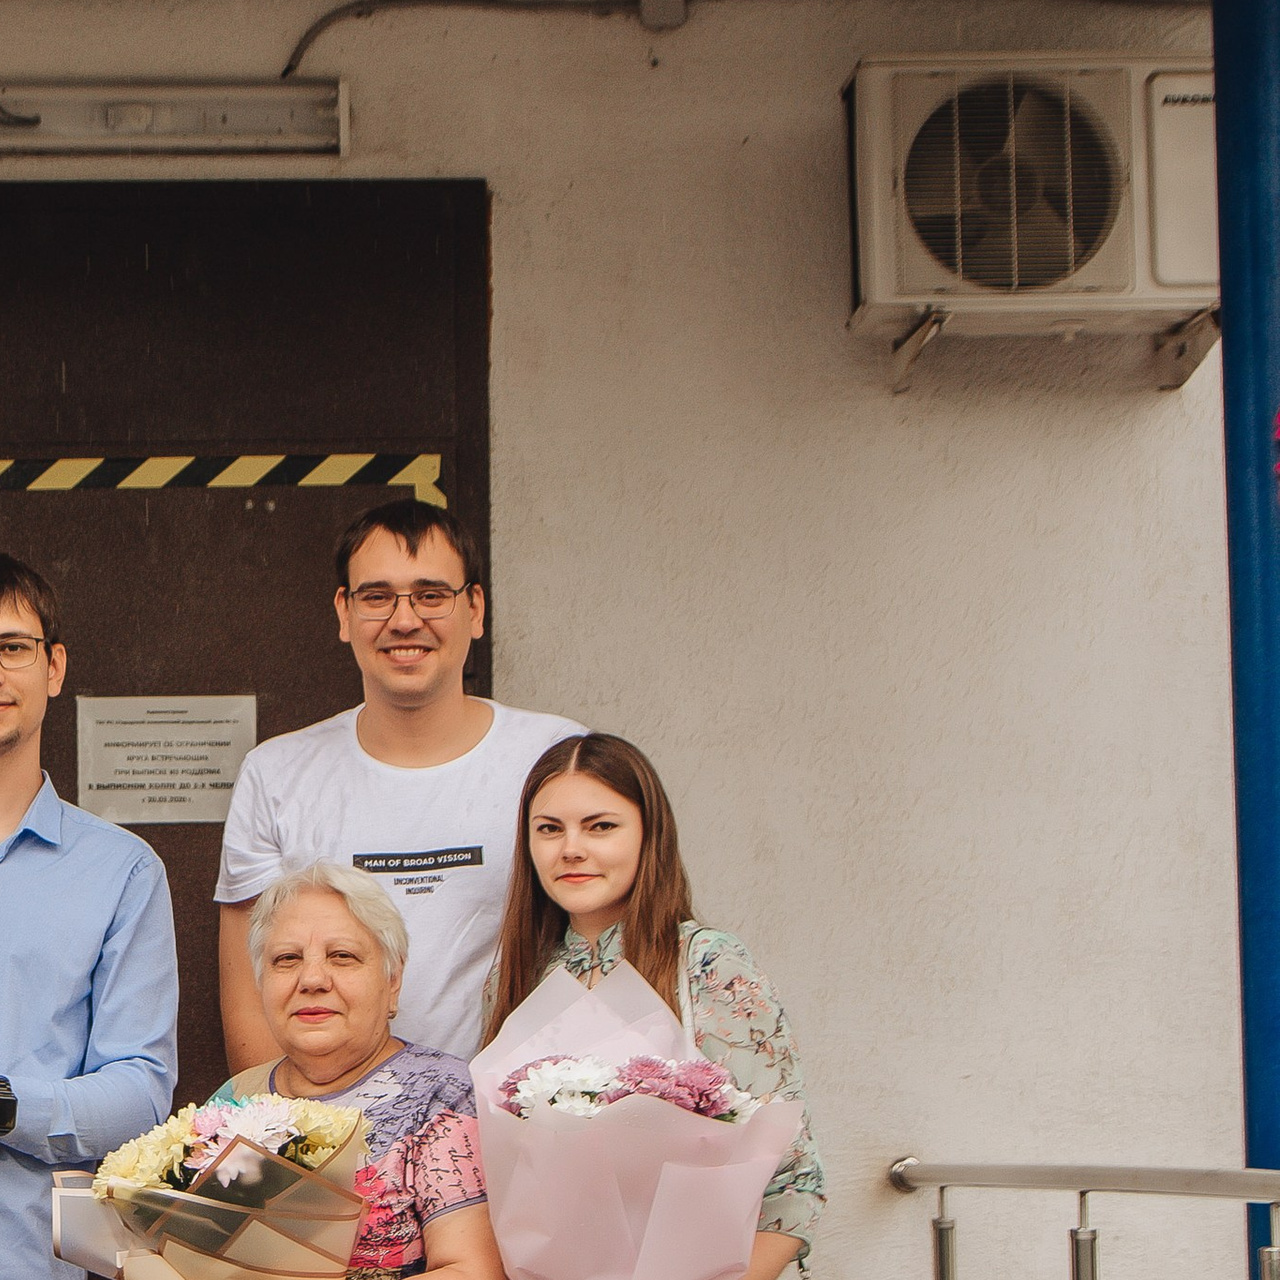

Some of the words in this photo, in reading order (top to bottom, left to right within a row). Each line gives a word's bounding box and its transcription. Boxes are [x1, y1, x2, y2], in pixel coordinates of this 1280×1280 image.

[364, 859, 385, 867] MAN
[387, 859, 402, 867] OF
[403, 857, 435, 867] BROAD
[437, 852, 472, 864] VISION
